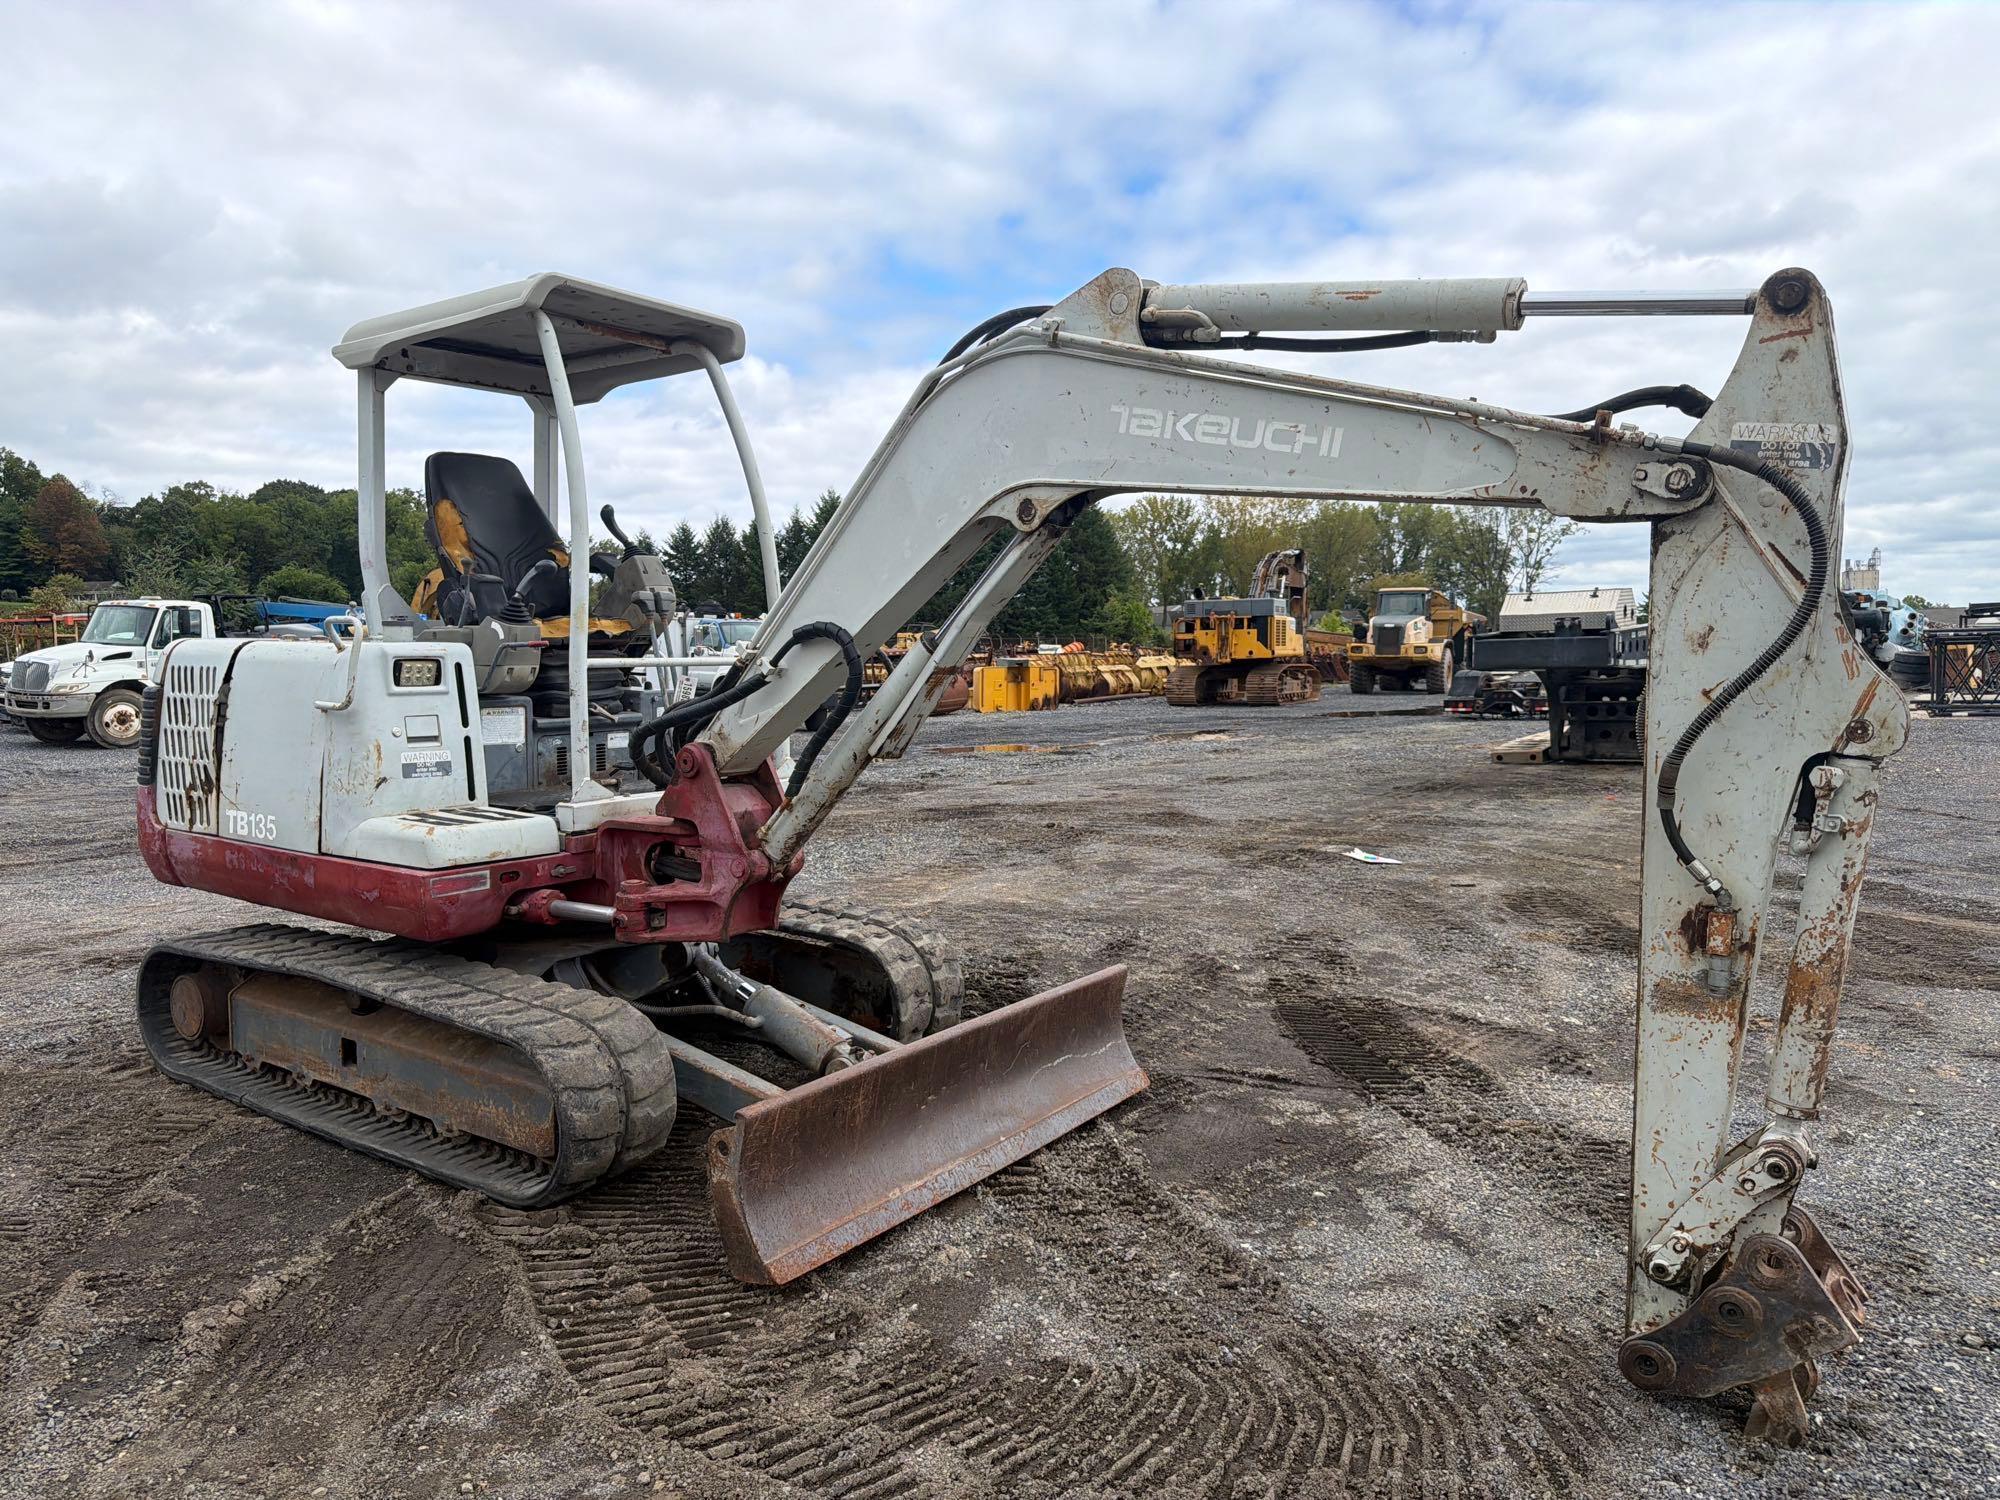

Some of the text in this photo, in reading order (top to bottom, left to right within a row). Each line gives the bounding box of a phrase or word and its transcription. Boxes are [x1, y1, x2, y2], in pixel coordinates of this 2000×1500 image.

[1738, 424, 1831, 441] WARNING
[1760, 441, 1776, 450] DO
[403, 752, 449, 763] WARNING
[225, 808, 277, 841] TB135
